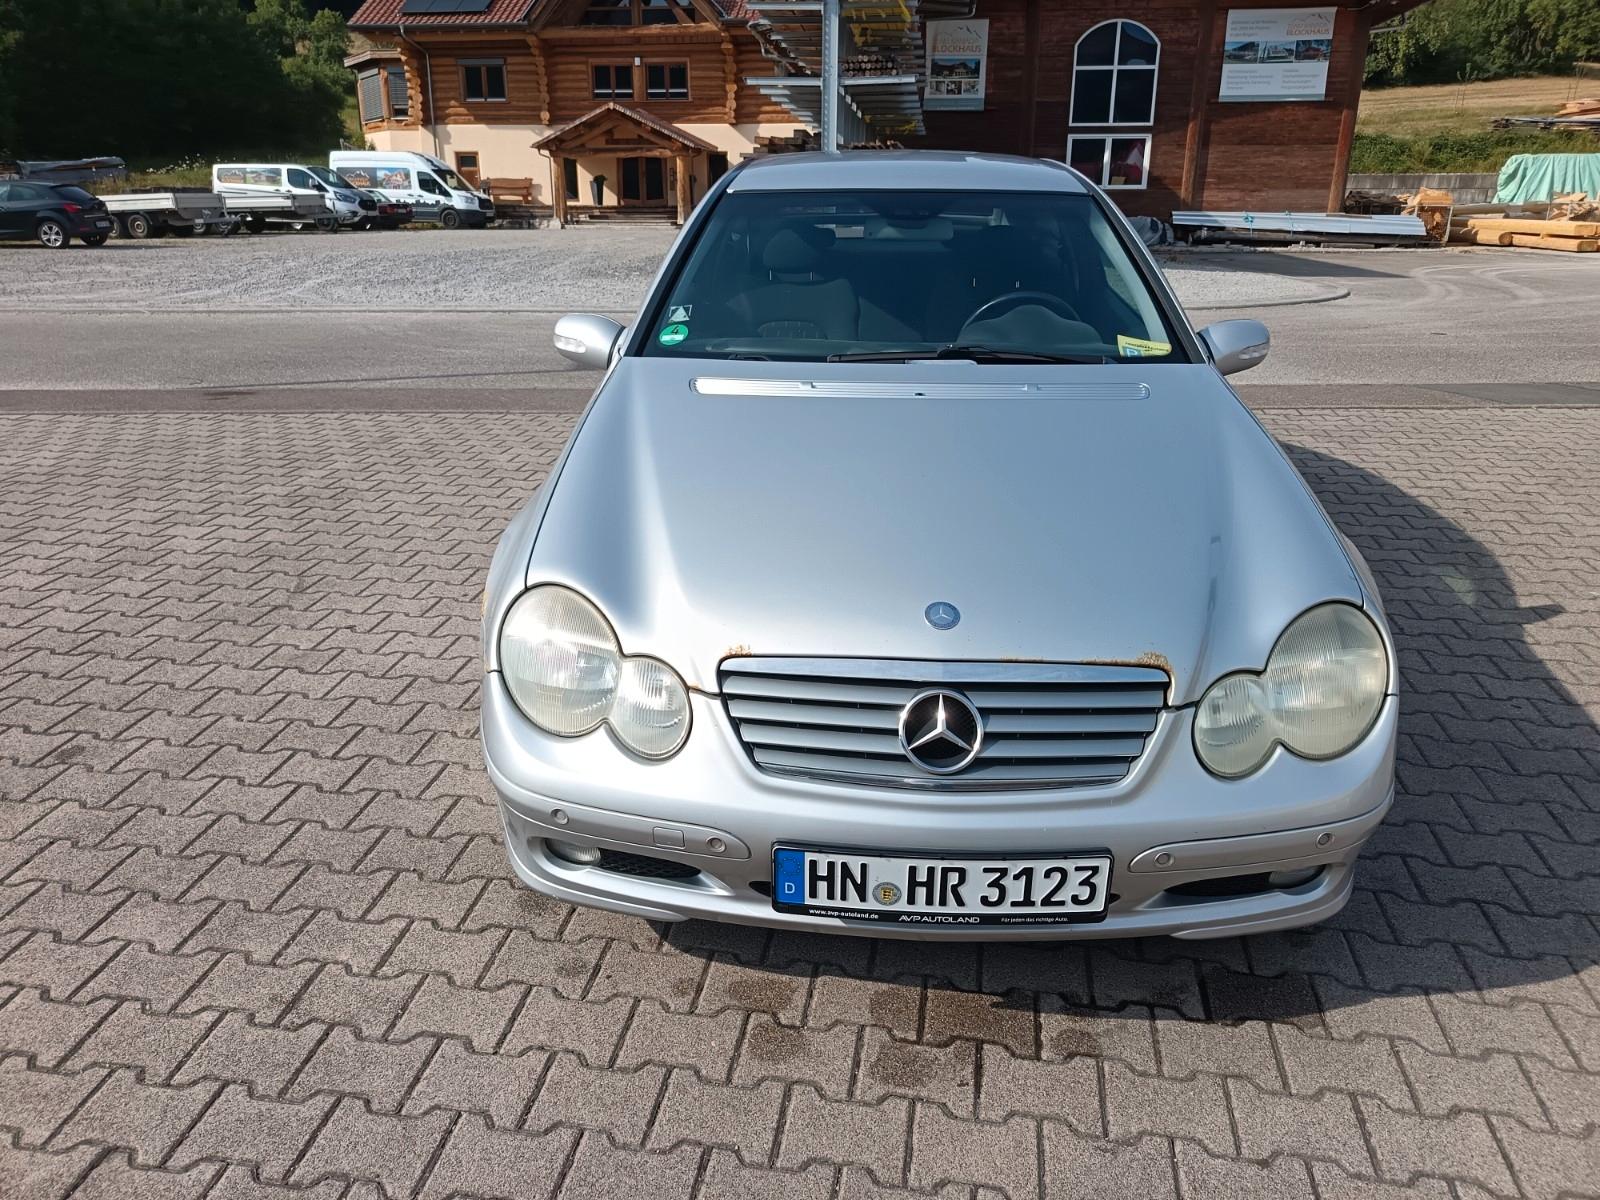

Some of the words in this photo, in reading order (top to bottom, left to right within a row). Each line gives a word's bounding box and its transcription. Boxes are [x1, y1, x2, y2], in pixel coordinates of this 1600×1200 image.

[671, 325, 680, 335] 4
[784, 882, 796, 894] D
[808, 859, 868, 903] HN
[906, 864, 967, 907] HR
[979, 865, 1099, 907] 3123
[808, 908, 879, 919] www.avp-autoland.de
[898, 914, 920, 922] AVP
[921, 915, 980, 924] AUTOLAND
